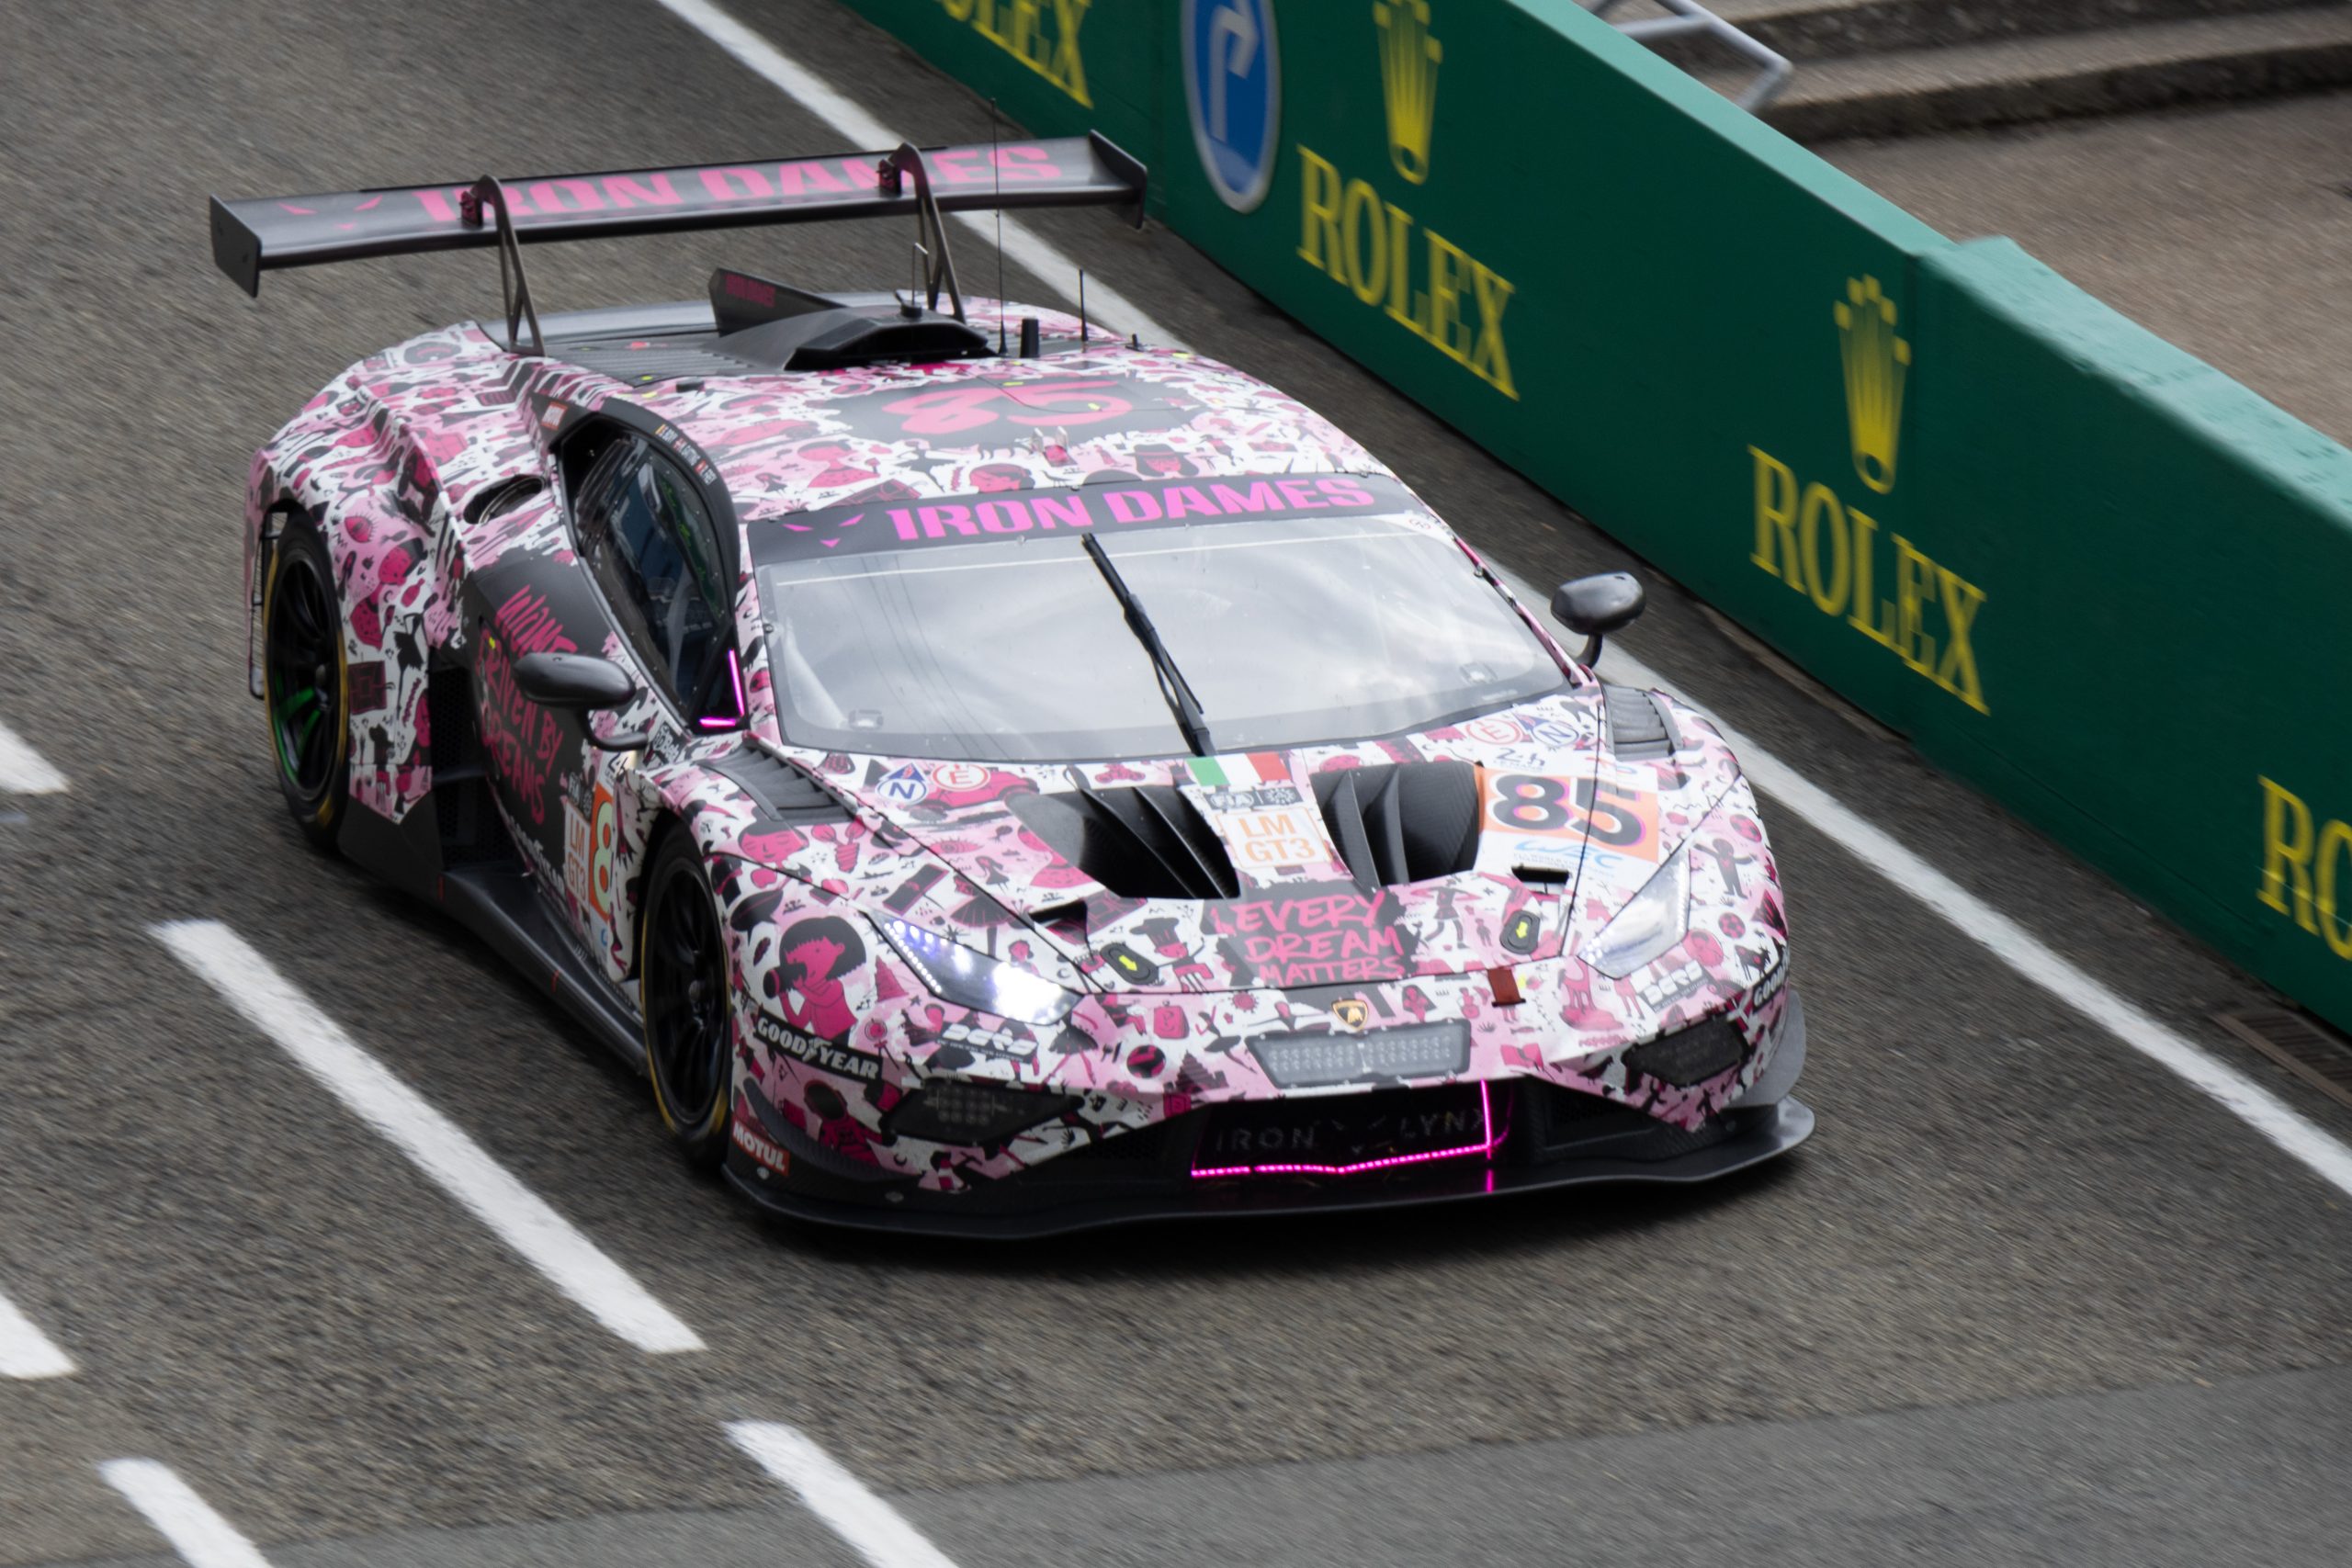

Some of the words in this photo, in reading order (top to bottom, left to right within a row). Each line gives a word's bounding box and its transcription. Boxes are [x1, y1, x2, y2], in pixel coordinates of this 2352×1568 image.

[1296, 142, 1520, 401] ROLEX
[881, 380, 1133, 434] 85
[886, 495, 1093, 540] IRON
[1103, 478, 1374, 524] DAMES
[1747, 443, 1991, 716] ROLEX
[1238, 813, 1297, 838] LM
[1486, 773, 1646, 847] 85
[1244, 837, 1316, 863] GT3
[1229, 890, 1385, 932] EVERY
[1244, 926, 1404, 964] DREAM
[1259, 955, 1406, 987] MATTERS
[733, 1121, 786, 1172] MOTUL
[1216, 1126, 1314, 1151] IRON
